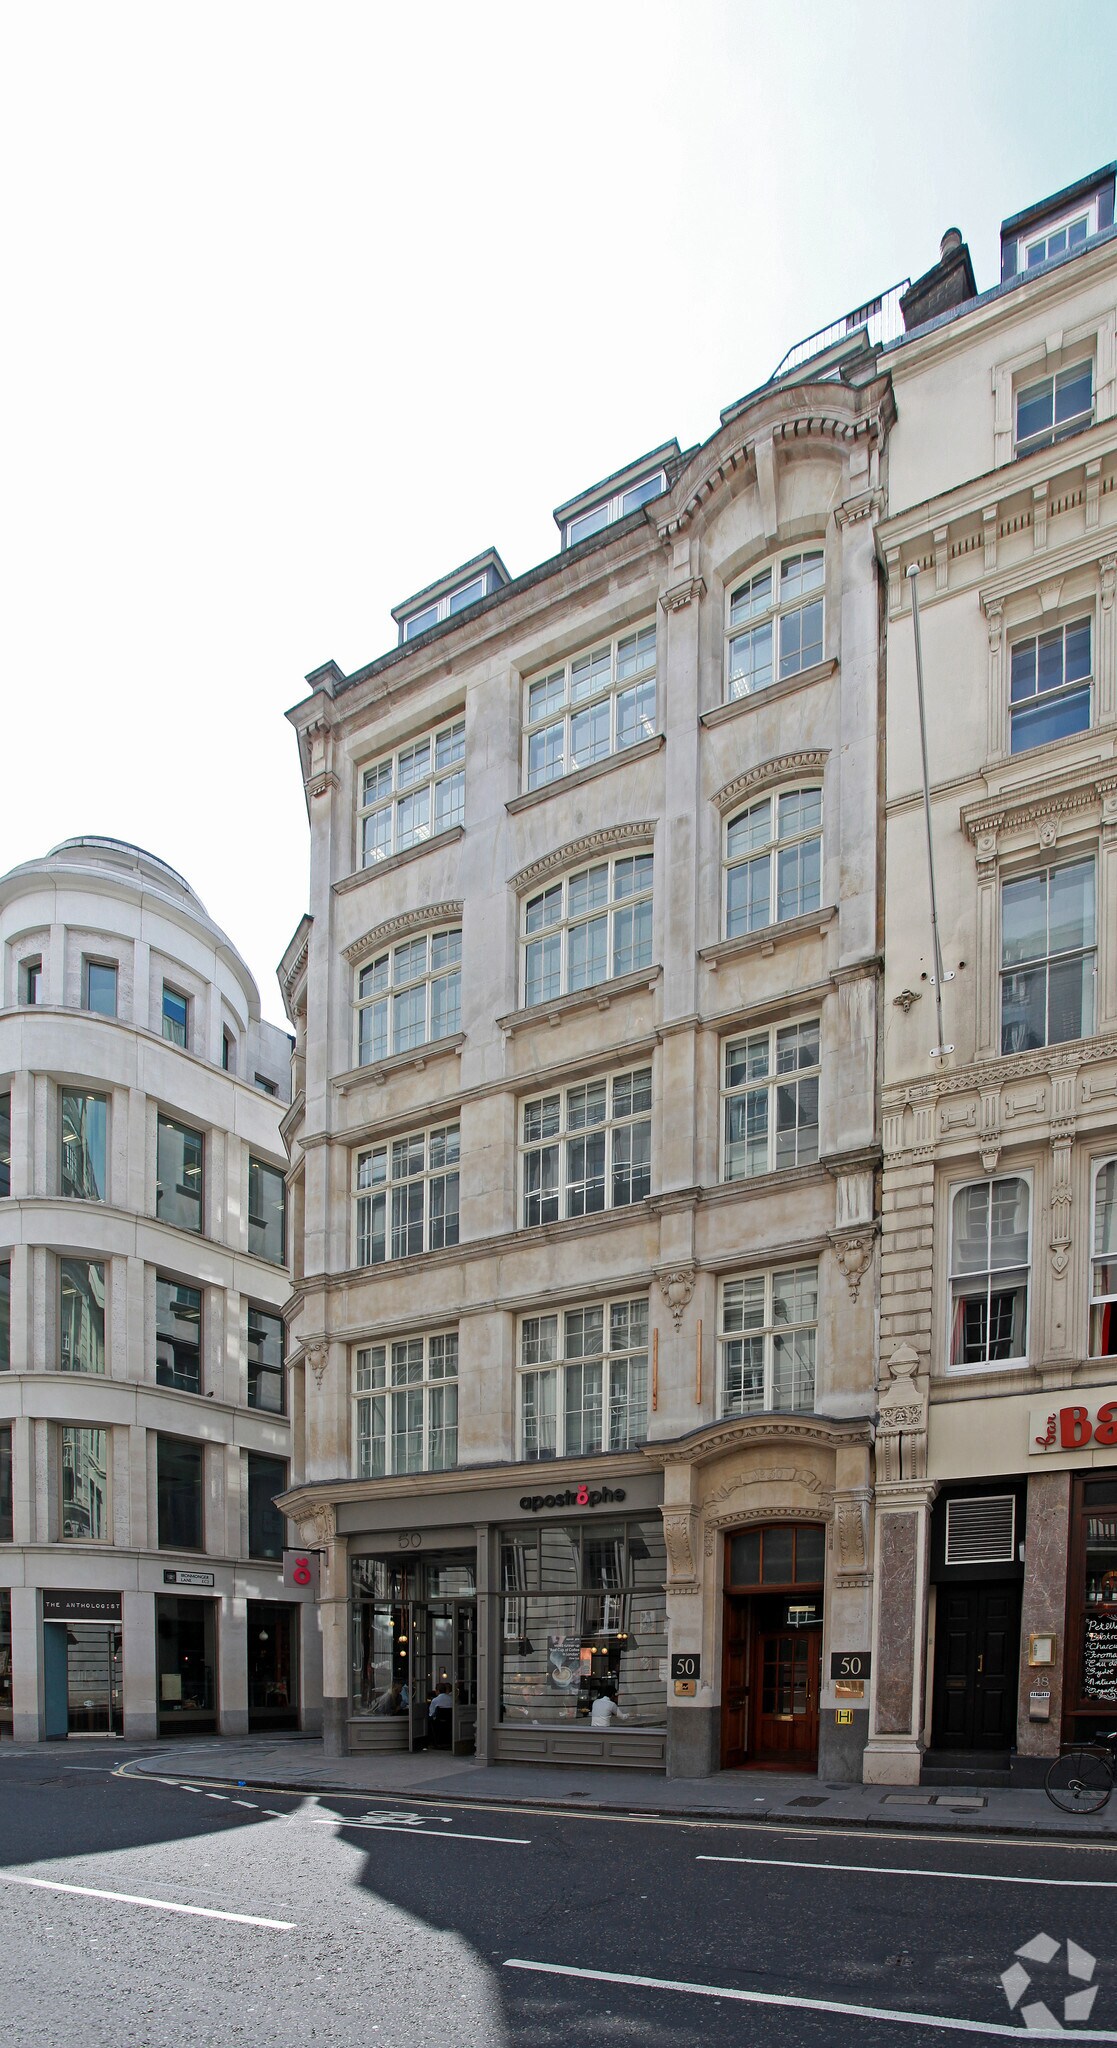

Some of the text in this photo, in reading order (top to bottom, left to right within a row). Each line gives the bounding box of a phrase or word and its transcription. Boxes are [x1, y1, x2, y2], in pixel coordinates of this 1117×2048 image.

[1035, 1412, 1057, 1451] bar
[519, 1484, 626, 1511] apostrophe
[398, 1532, 422, 1549] 50
[66, 1602, 120, 1610] ANTHOLOGIST
[676, 1658, 695, 1675] 50
[840, 1657, 862, 1675] 50
[1033, 1676, 1049, 1687] 48
[838, 1711, 849, 1722] H
